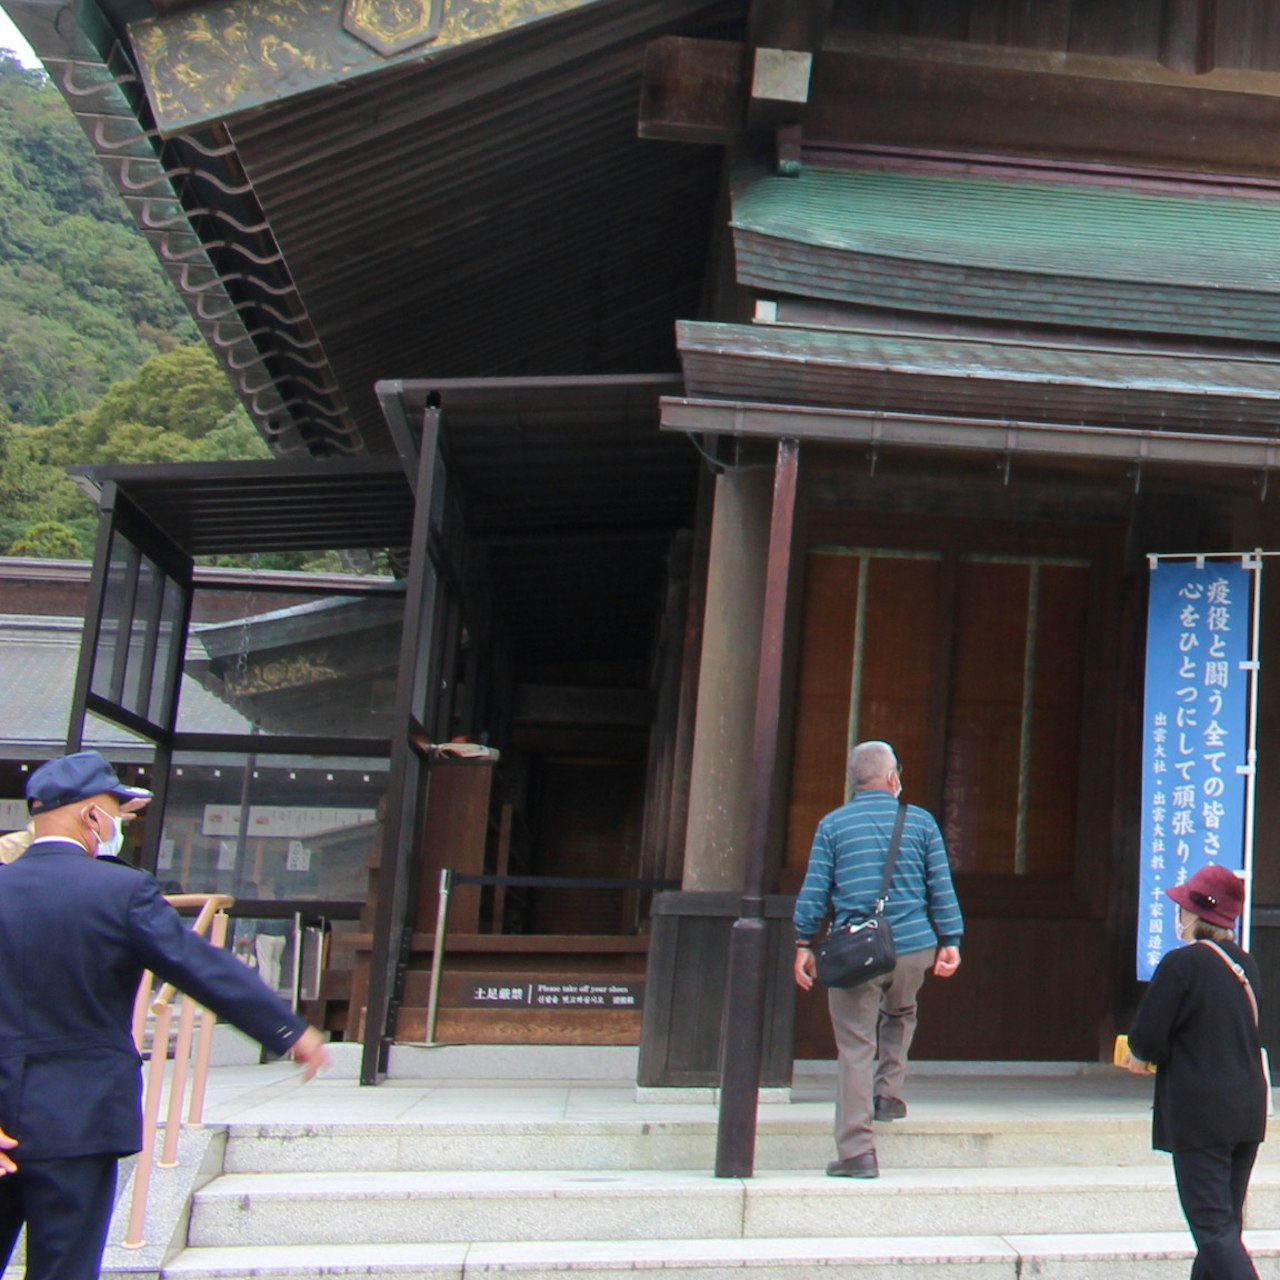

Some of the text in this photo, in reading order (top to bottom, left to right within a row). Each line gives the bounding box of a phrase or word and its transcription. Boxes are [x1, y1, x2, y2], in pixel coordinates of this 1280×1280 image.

[1202, 577, 1232, 866] 疫役と闘う全ての皆さ
